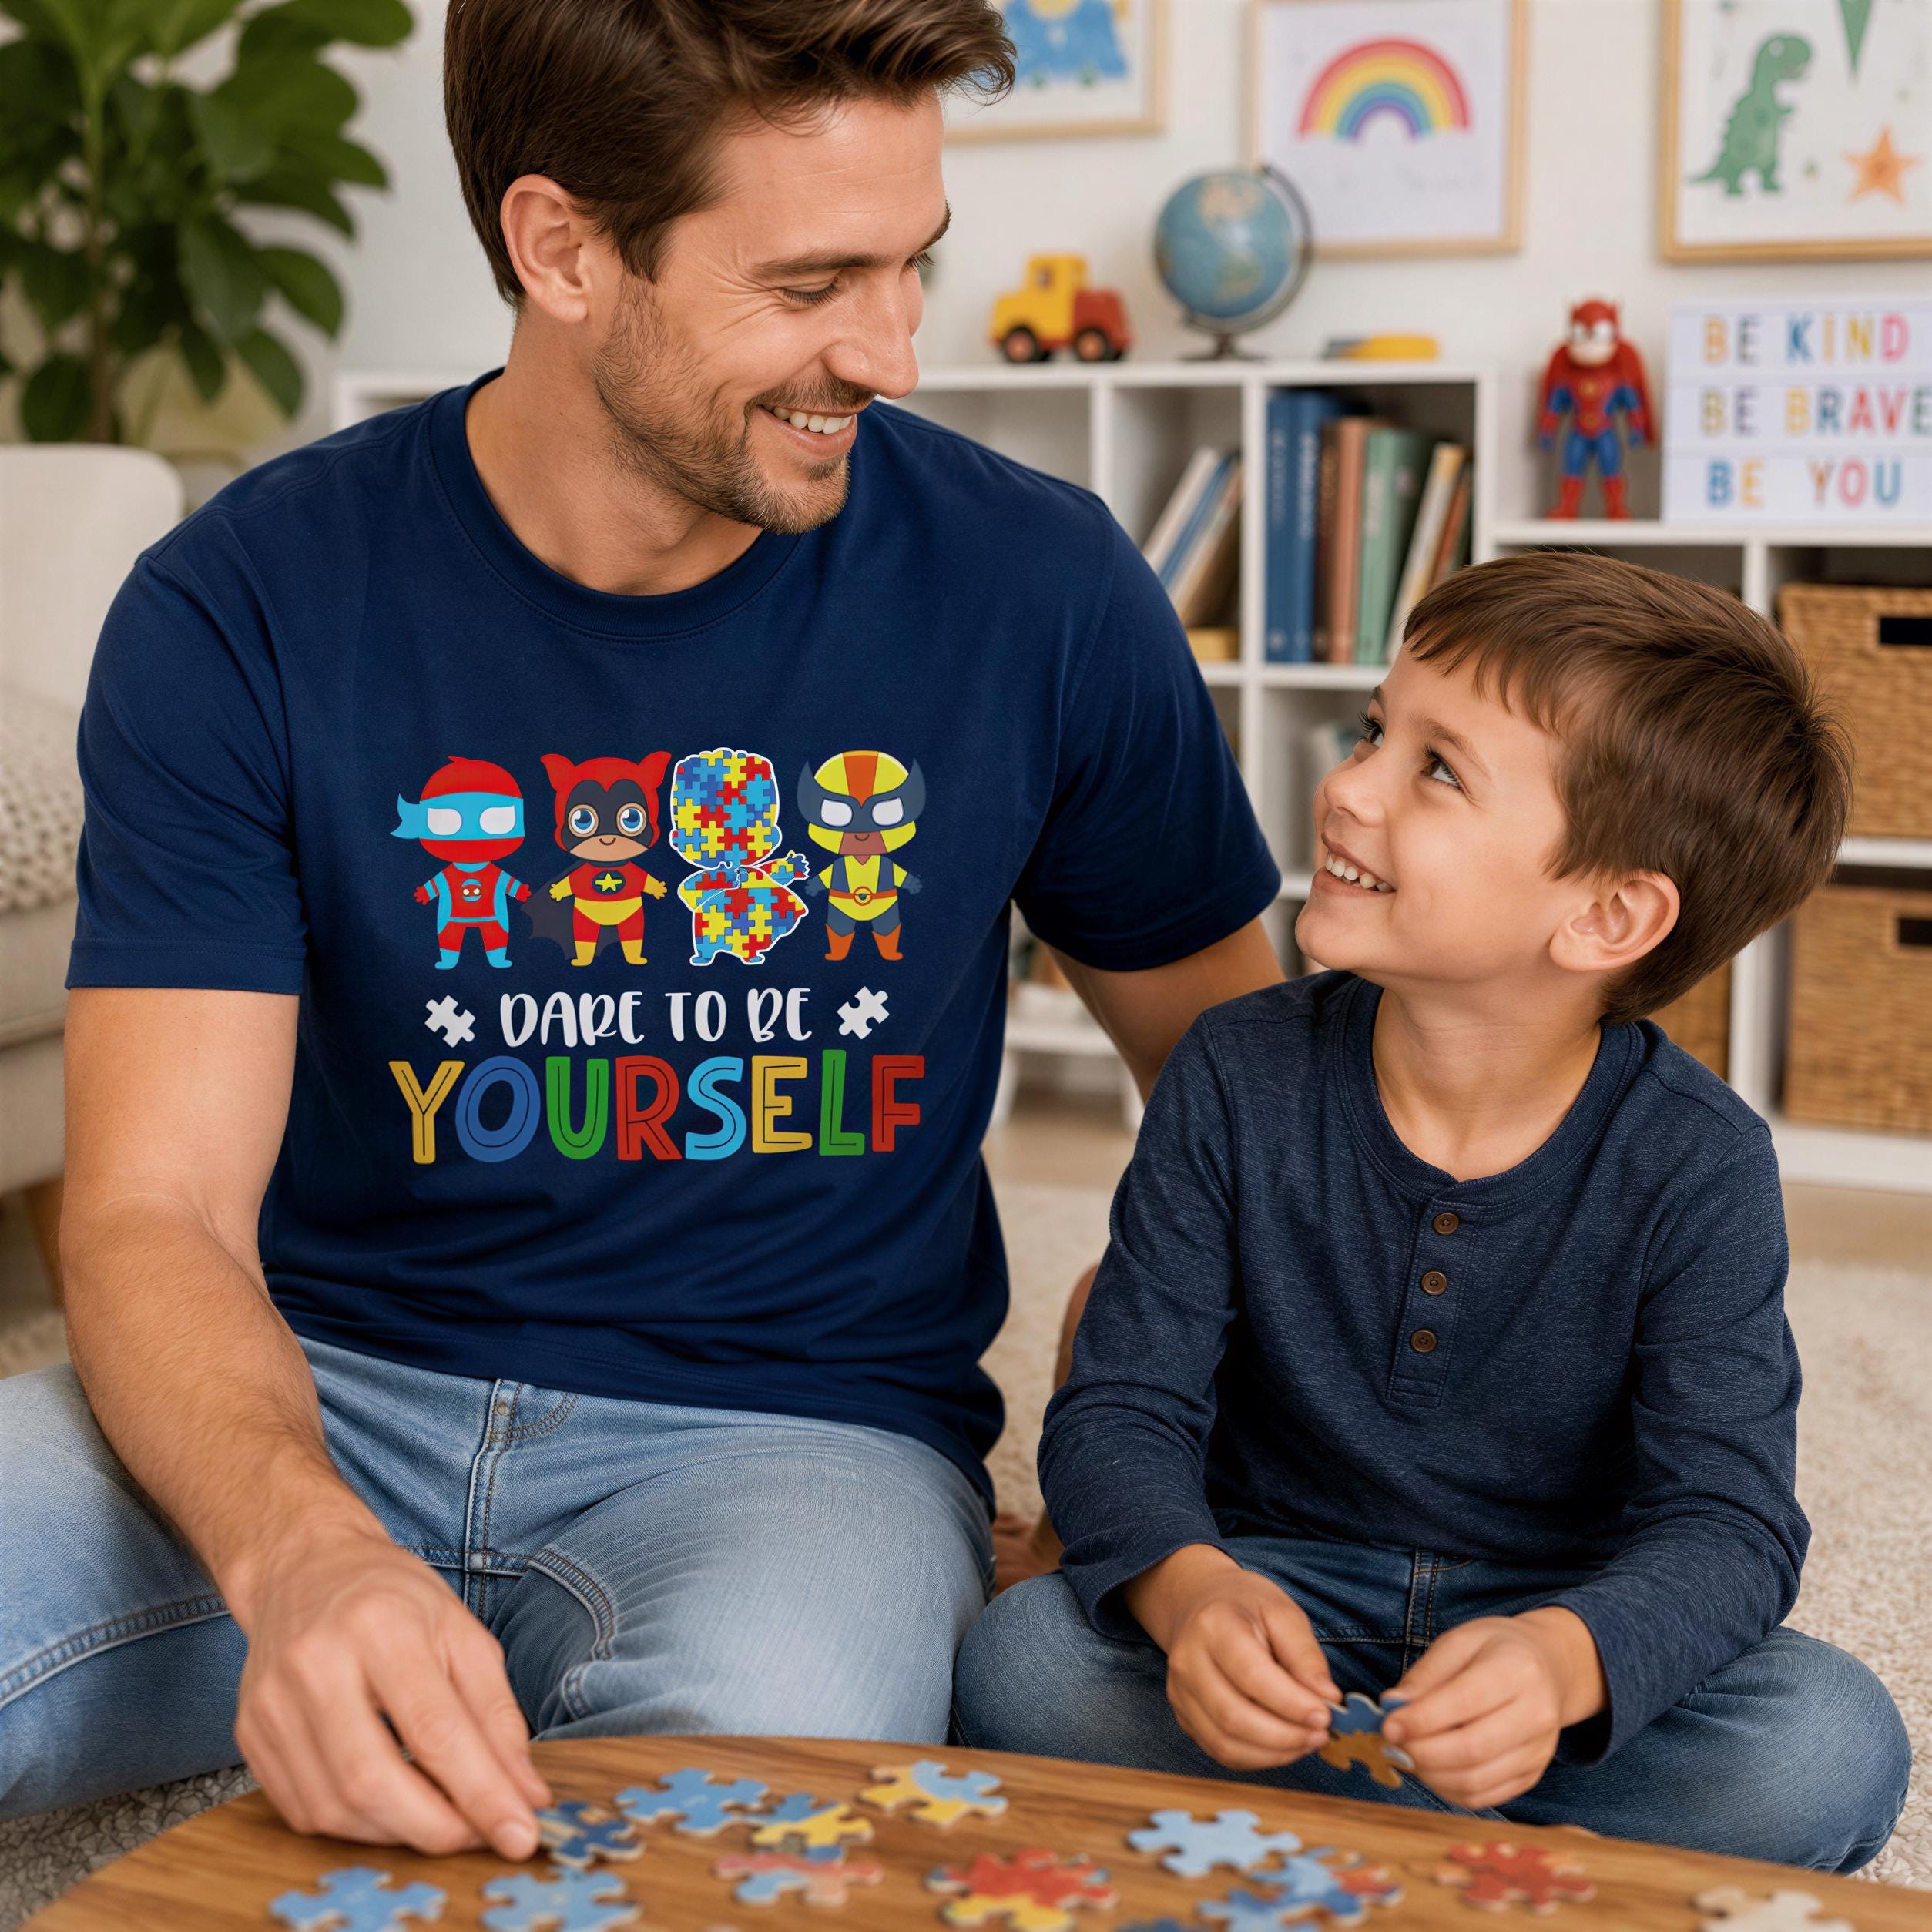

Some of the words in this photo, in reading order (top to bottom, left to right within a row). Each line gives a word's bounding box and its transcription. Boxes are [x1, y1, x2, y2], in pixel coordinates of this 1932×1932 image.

[1703, 314, 1763, 364] BE
[1786, 313, 1910, 364] KIND
[1701, 387, 1759, 435] BE
[1785, 387, 1932, 436] BRAVE
[1706, 458, 1766, 509] BE
[1807, 458, 1903, 509] YOU
[499, 991, 645, 1048] DARE
[665, 991, 727, 1042] TO
[746, 988, 813, 1043] BE
[388, 1049, 925, 1164] YOURSELF
